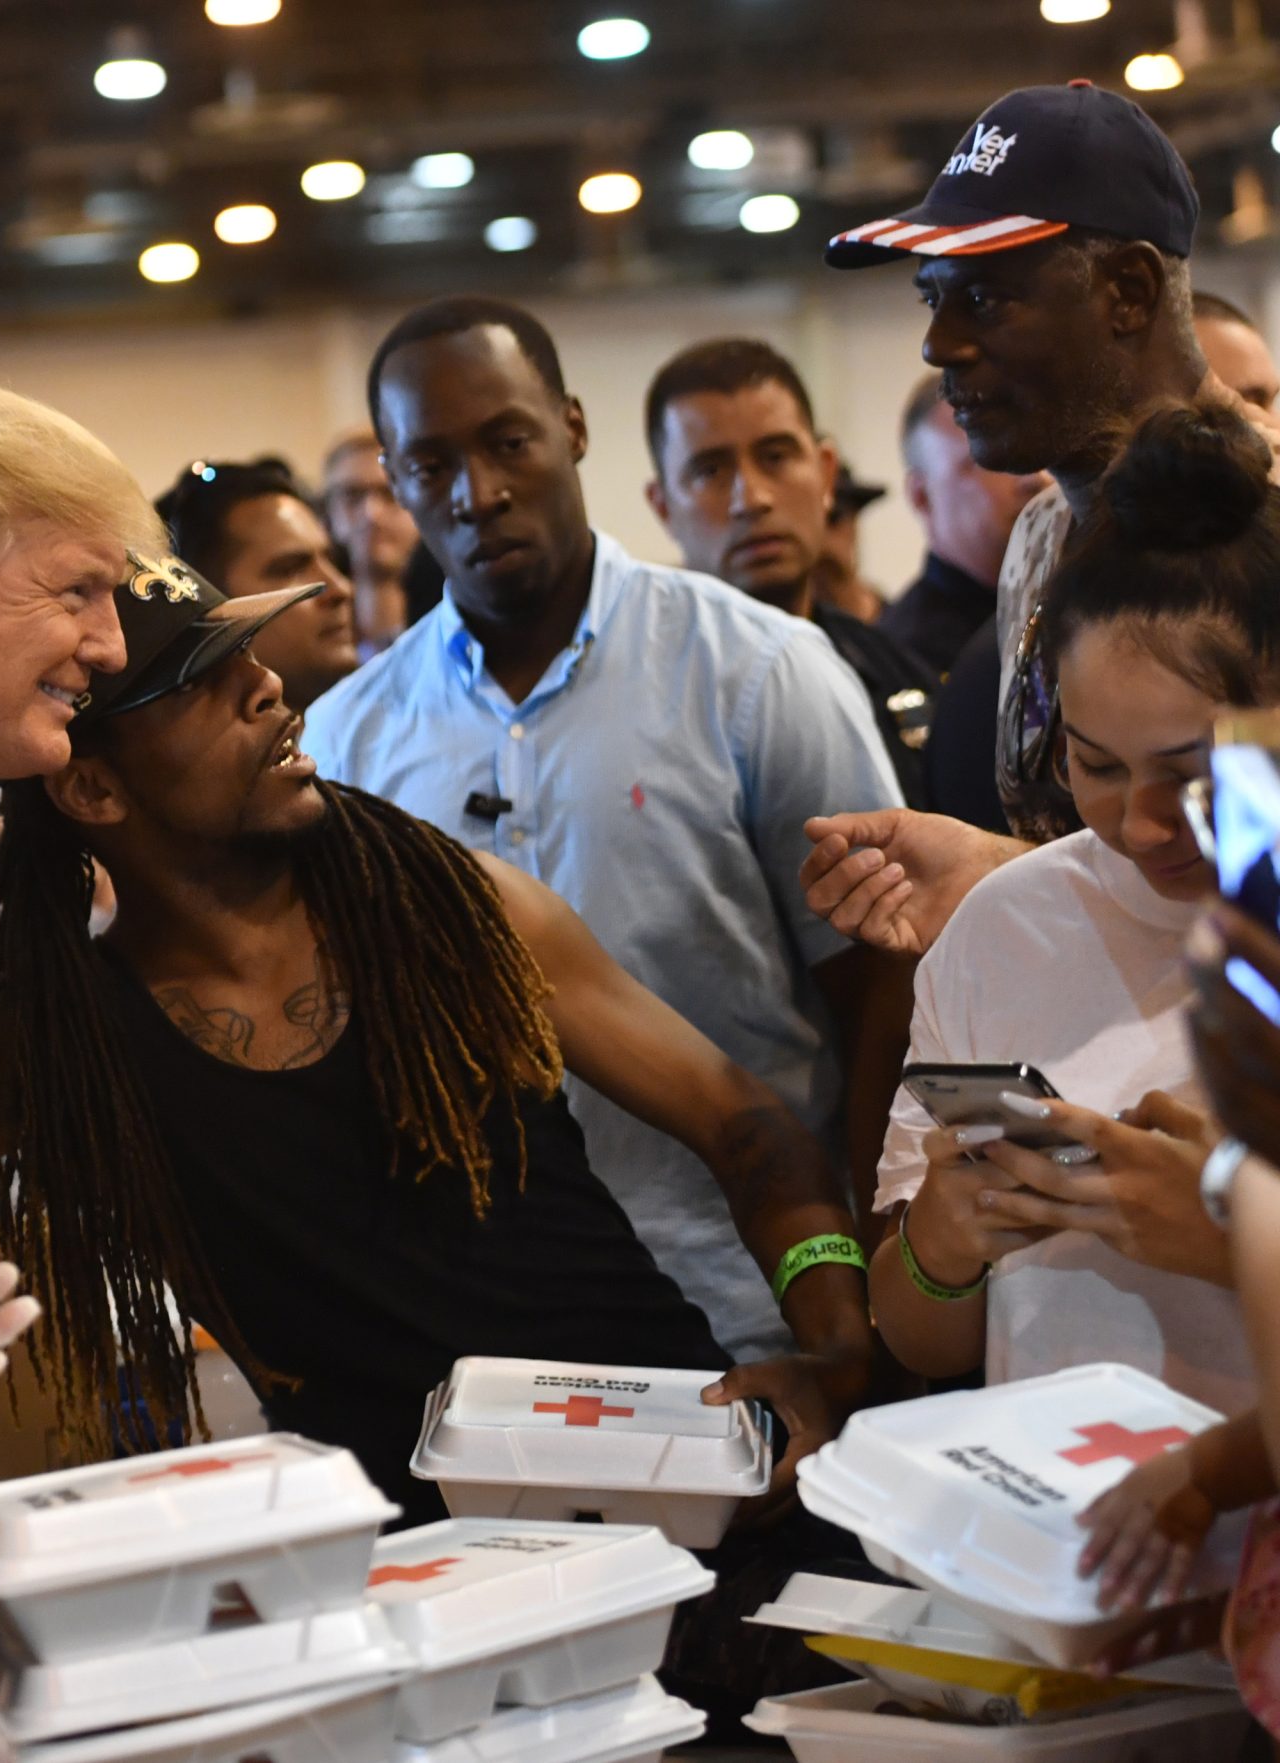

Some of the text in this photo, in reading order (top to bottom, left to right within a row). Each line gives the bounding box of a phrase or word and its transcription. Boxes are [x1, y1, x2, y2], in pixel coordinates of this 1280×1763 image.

[972, 122, 1018, 157] Vet
[534, 1380, 650, 1394] American
[535, 1374, 650, 1389] Red Cross
[940, 1448, 1042, 1506] Red Cross
[964, 1446, 1067, 1501] American
